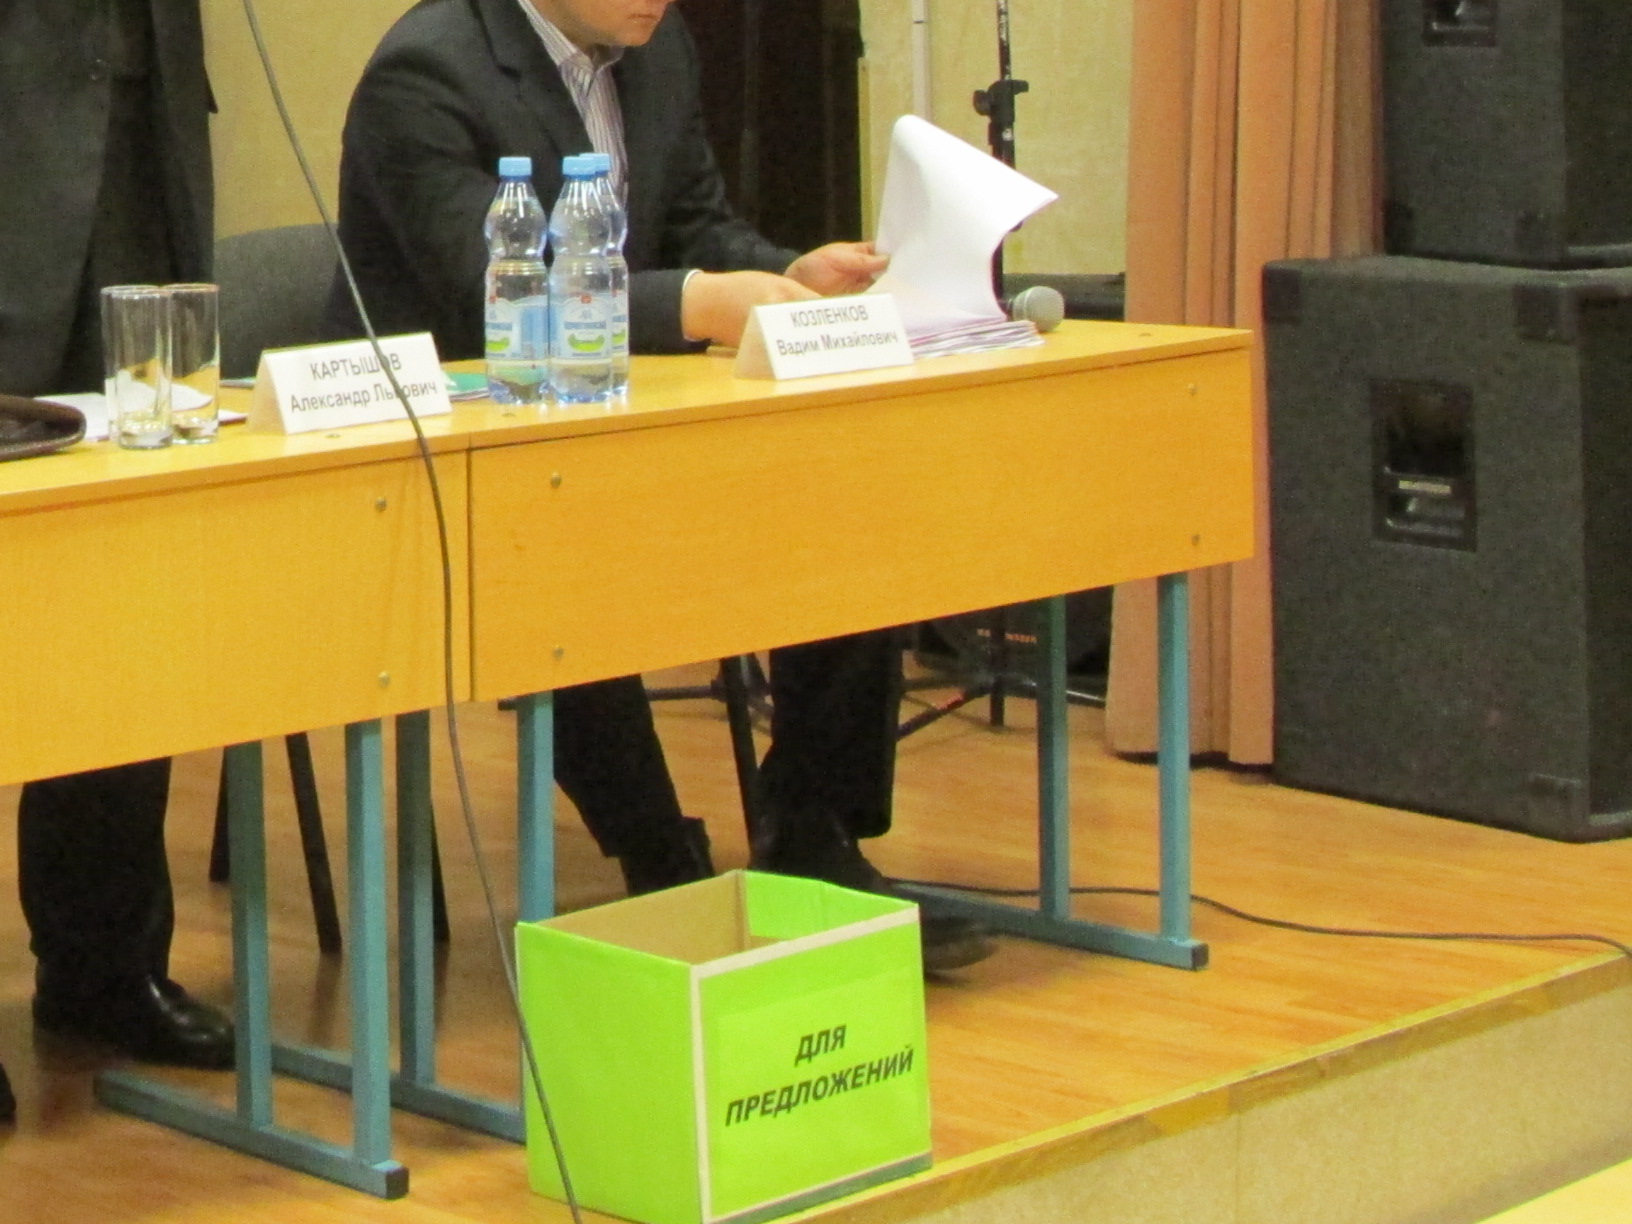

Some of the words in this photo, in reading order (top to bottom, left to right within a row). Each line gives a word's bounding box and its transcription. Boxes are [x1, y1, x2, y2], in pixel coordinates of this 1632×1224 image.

[790, 305, 869, 328] КОЗЛЕНКОВ
[776, 337, 819, 356] Вадим
[821, 329, 898, 350] Михайлович
[310, 353, 401, 381] КАРТЫШВ
[291, 390, 371, 413] Александр
[374, 380, 438, 403] Льович
[794, 1024, 847, 1067] ДЛЯ
[725, 1044, 914, 1127] ПРЕДЛОЖЕНИЙ
